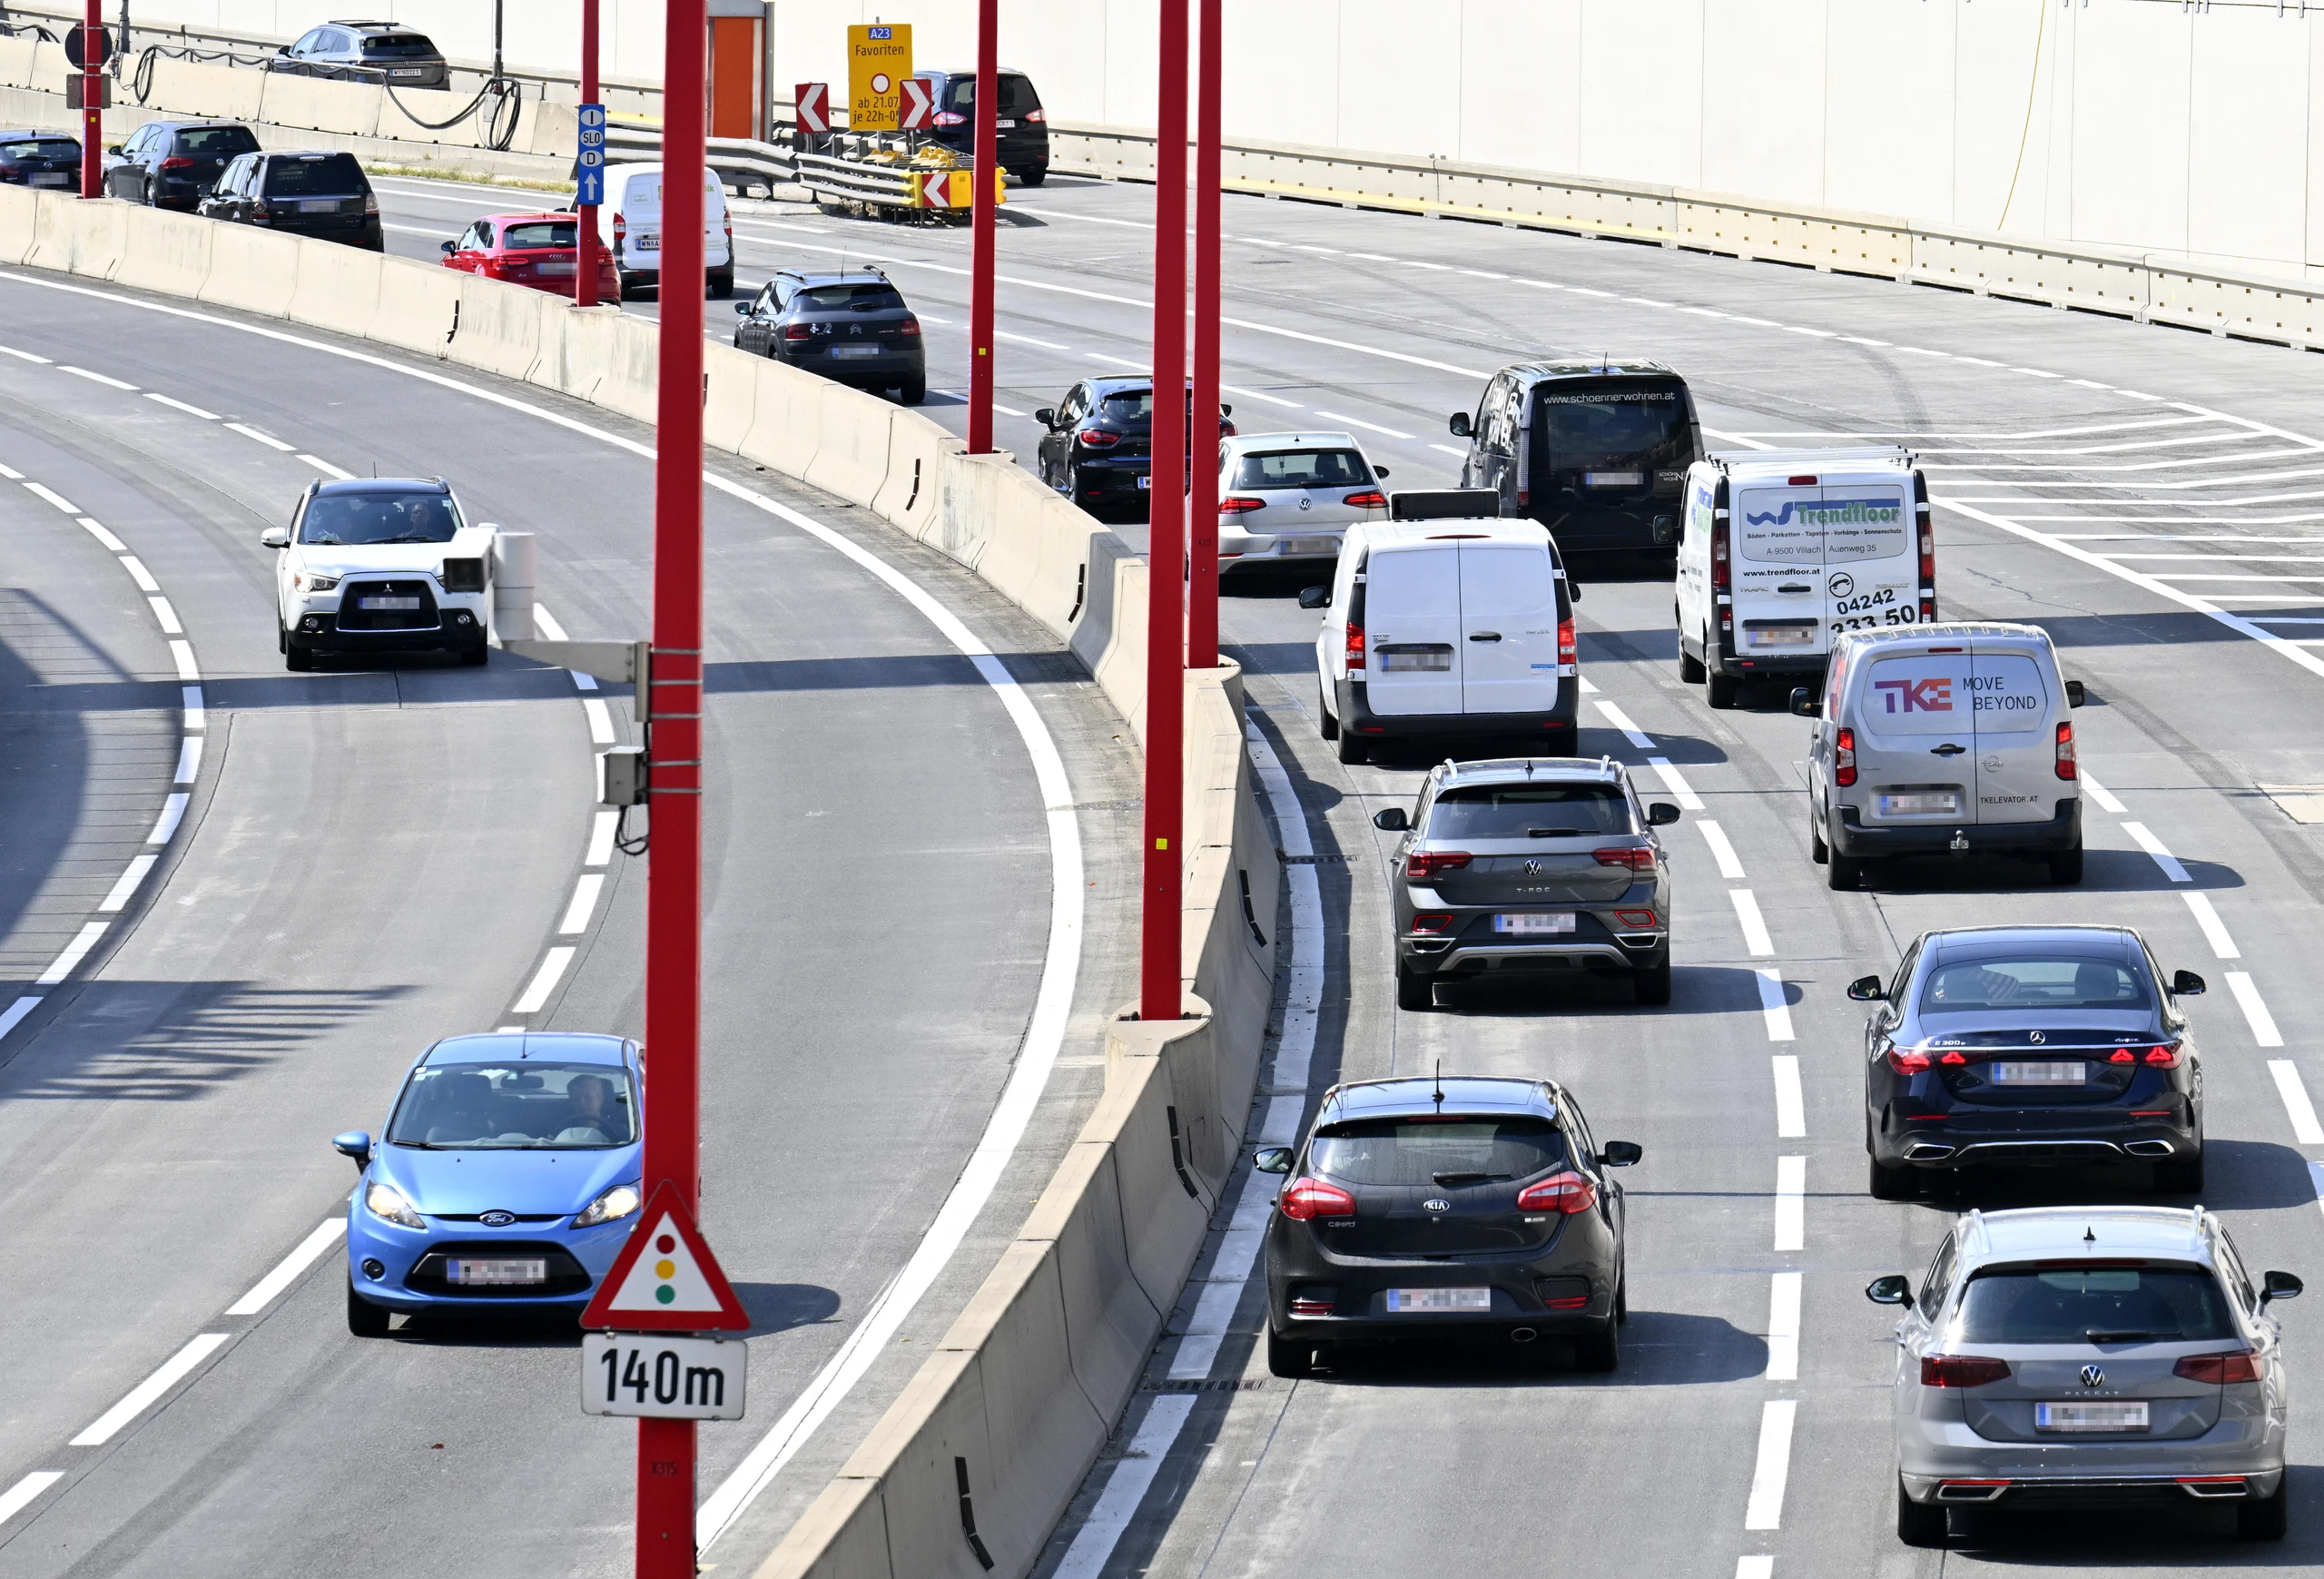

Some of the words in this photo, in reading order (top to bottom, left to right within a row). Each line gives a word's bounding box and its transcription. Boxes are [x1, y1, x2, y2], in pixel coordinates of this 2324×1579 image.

[871, 28, 891, 39] A23
[855, 44, 904, 55] Favoriten
[858, 97, 870, 108] ab
[590, 111, 594, 124] I
[852, 111, 863, 124] je
[583, 133, 601, 143] SLO
[586, 153, 596, 164] D
[1543, 391, 1676, 404] www.schoennerwohnen.at
[1797, 501, 1900, 525] Trendfloor
[1797, 546, 1821, 554] Villach
[1828, 545, 1865, 553] Auenweg
[1866, 544, 1876, 552] 35
[1743, 567, 1821, 577] www.trendfloor.at
[1837, 588, 1896, 615] 04242
[1886, 605, 1915, 626] 50
[1875, 678, 1953, 714] TKE
[1963, 676, 2004, 691] MOVE
[1974, 696, 2037, 711] BEYOND
[1980, 795, 2039, 804] TKELEVATOR.AT
[1428, 1201, 1445, 1209] KIA
[487, 1214, 507, 1223] Ford
[601, 1347, 724, 1406] 140m
